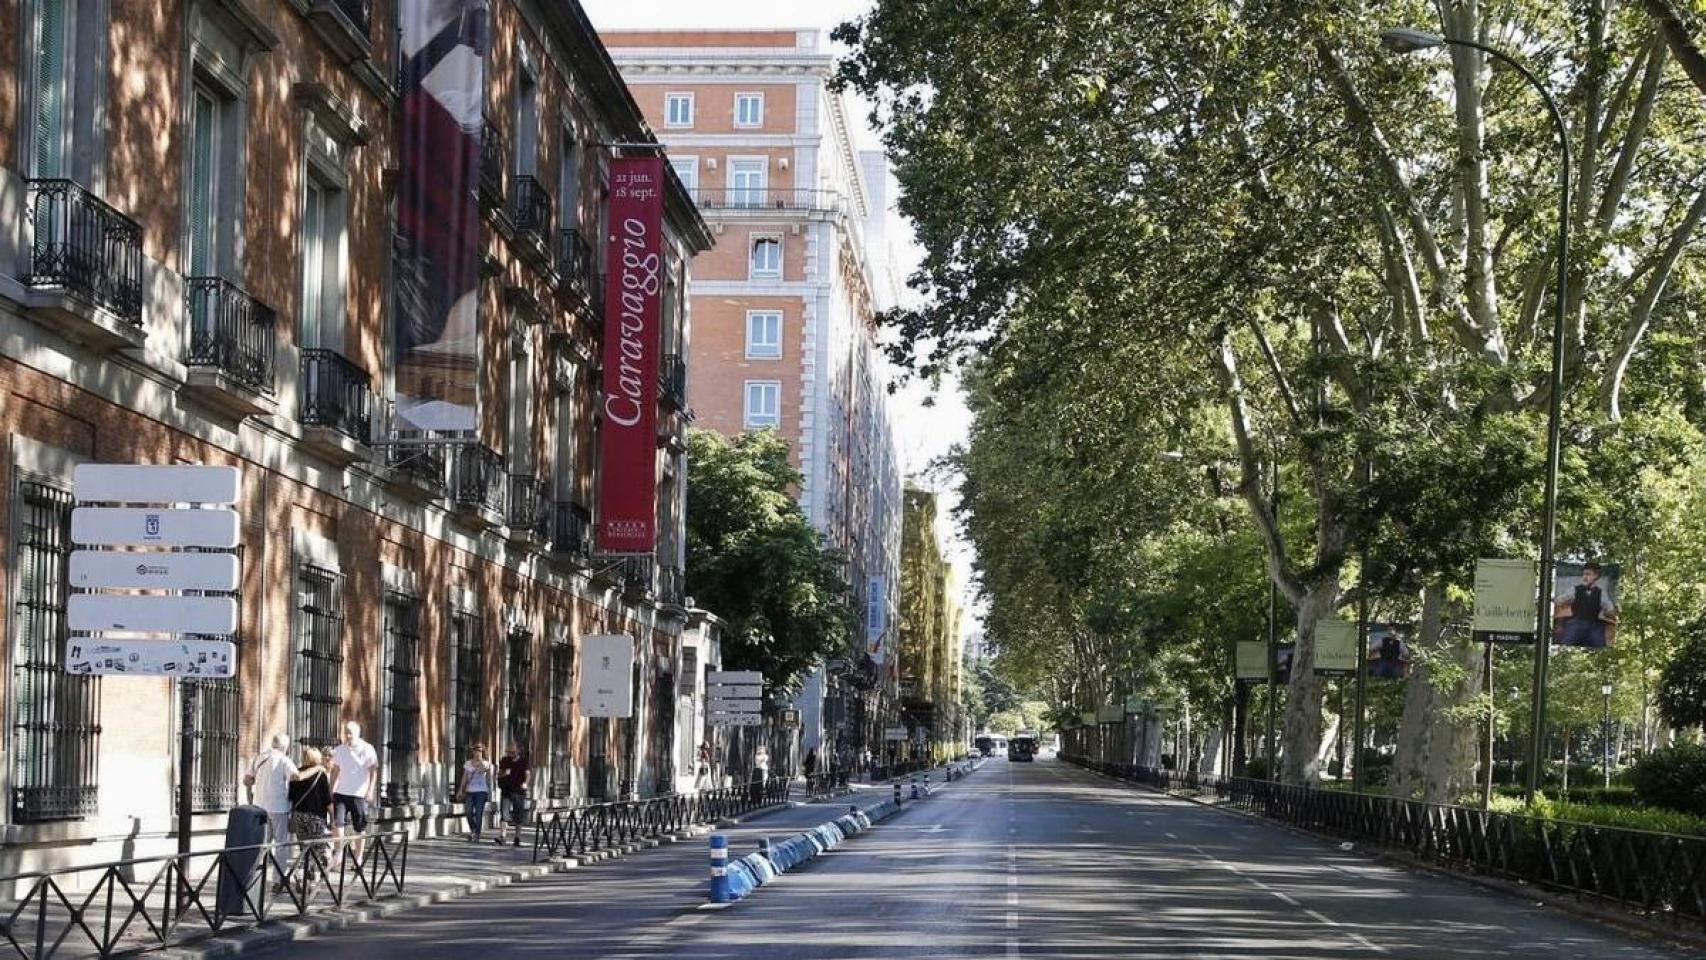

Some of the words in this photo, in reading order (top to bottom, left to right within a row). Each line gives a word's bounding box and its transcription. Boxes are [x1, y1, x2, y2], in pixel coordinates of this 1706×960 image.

[615, 174, 627, 183] 21
[629, 170, 653, 186] jun.
[615, 187, 627, 198] 18
[630, 188, 657, 201] sept.
[605, 217, 660, 427] Caravaggio
